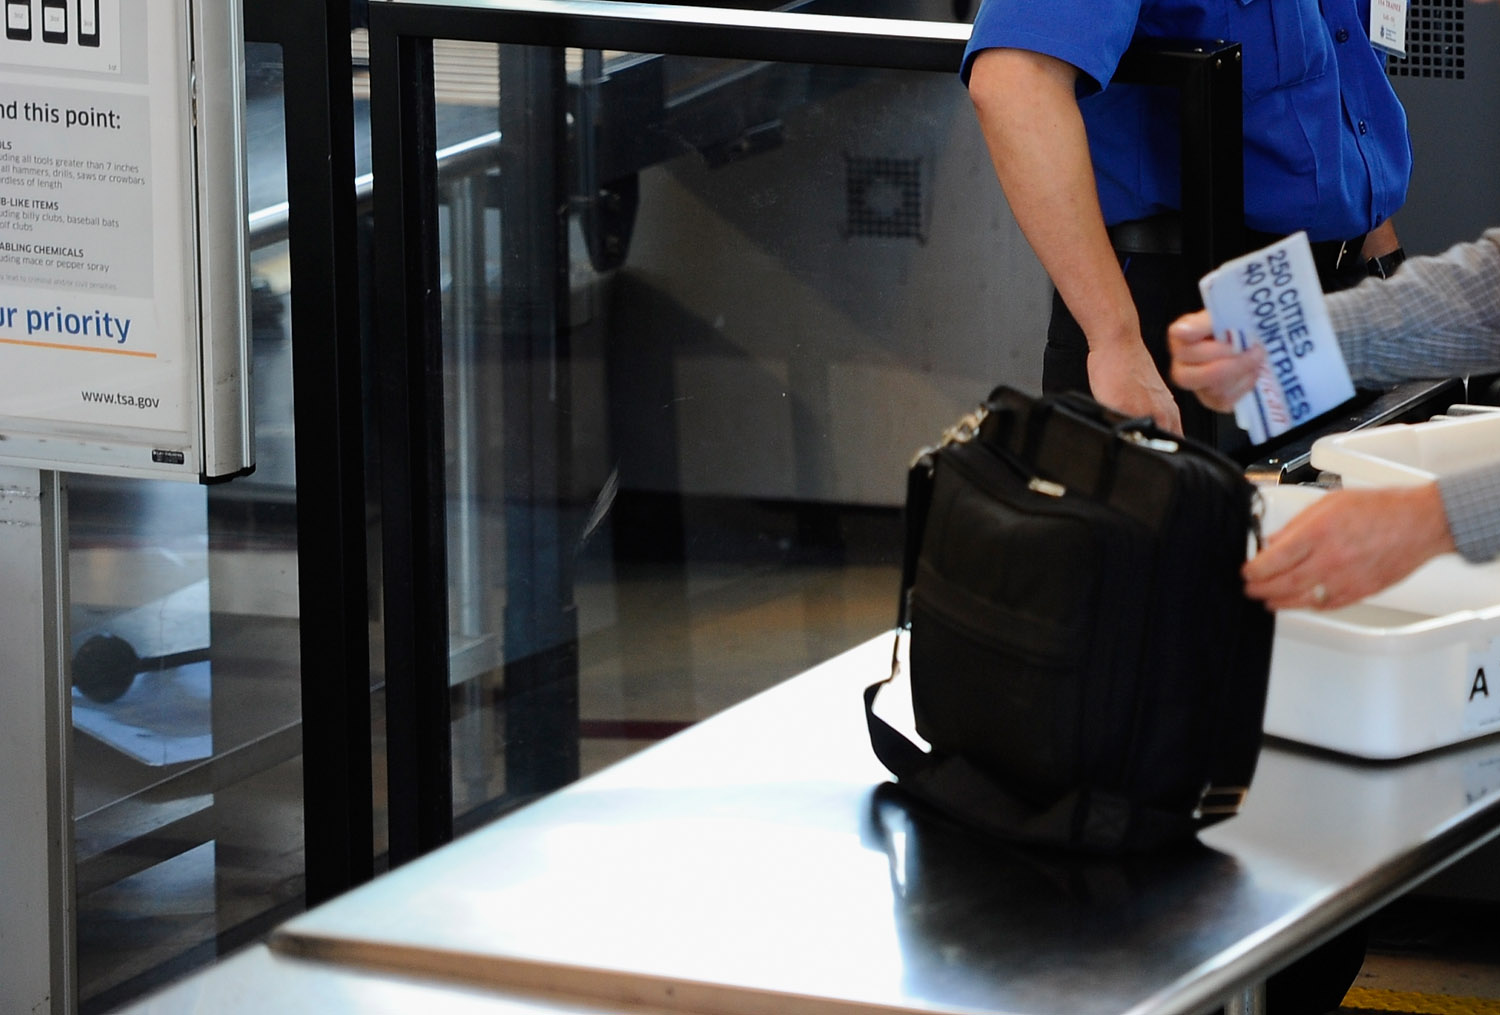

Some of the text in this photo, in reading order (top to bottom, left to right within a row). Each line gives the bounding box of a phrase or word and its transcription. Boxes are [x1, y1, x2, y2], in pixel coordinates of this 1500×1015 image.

[24, 102, 60, 124] this
[66, 107, 121, 129] point:
[0, 140, 12, 150] LS
[22, 154, 32, 164] all
[34, 156, 54, 166] tools
[55, 159, 84, 168] greater
[86, 161, 105, 171] than
[107, 162, 112, 171] 7
[114, 163, 139, 174] inches
[0, 176, 63, 190] rdless of length
[1, 164, 146, 186] all hammers, drills, saws or crowbars
[0, 197, 60, 211] B-LIKE ITEMS
[12, 221, 34, 232] clubs
[22, 211, 40, 222] billy
[42, 213, 65, 225] clubs,
[67, 215, 100, 227] baseball
[102, 218, 120, 229] bats
[0, 242, 85, 258] ABLING CHEMICALS
[22, 257, 44, 267] mace
[45, 258, 55, 266] or
[56, 259, 85, 270] pepper
[87, 262, 110, 273] spray
[1266, 249, 1314, 359] 250 CITIES
[26, 306, 131, 344] priority
[1244, 261, 1311, 422] 40 COUNTRIES
[81, 390, 160, 409] www.tsa.gov
